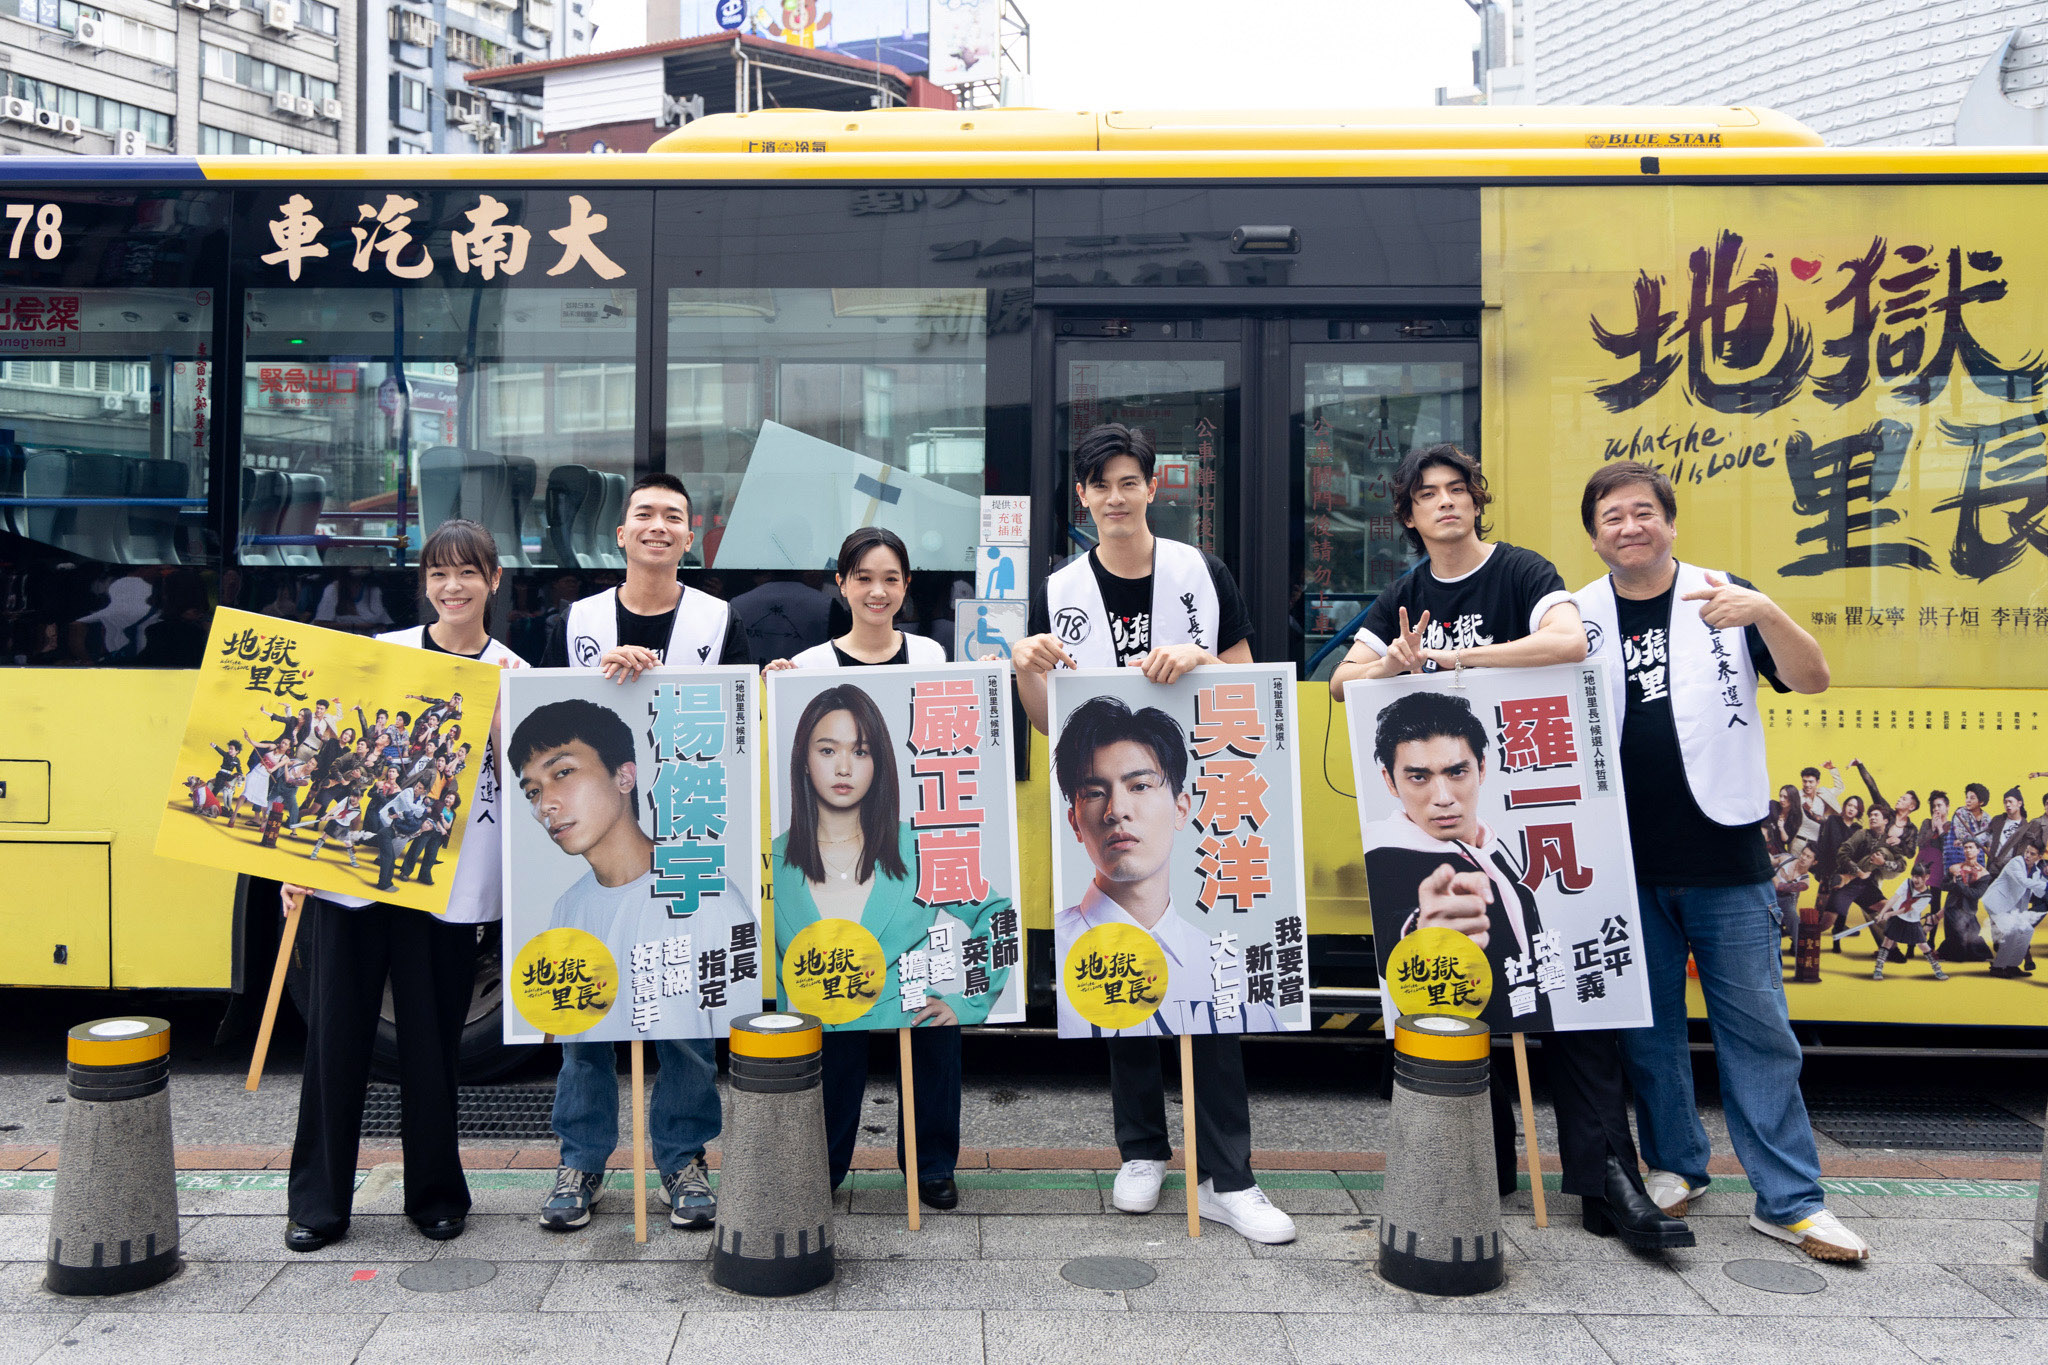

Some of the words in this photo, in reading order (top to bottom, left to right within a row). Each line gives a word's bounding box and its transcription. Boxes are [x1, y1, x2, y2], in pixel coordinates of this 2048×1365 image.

[1608, 133, 1660, 144] BLUE
[1669, 133, 1721, 144] STAR
[5, 203, 62, 260] 78
[1587, 228, 2048, 418] 地獄
[259, 368, 357, 393] 緊急出口
[268, 396, 324, 406] Emergency
[328, 396, 347, 406] Exit
[998, 513, 1023, 525] 充電
[1311, 416, 1334, 636] 公車關門後請勿上車
[1777, 408, 2048, 585] 里長
[998, 525, 1023, 537] 插座
[1055, 611, 1088, 642] 78
[1811, 611, 1837, 626] 導演
[1844, 605, 1906, 627] 瞿友寧
[1990, 605, 2048, 627] 李青蓉
[221, 628, 301, 668] 地獄
[245, 665, 309, 701] 里長
[647, 682, 729, 917] 楊傑宇
[906, 678, 990, 907] 嚴正嵐
[1189, 682, 1273, 914] 吳承洋
[1495, 695, 1594, 895] 羅一凡
[662, 934, 693, 998] 超級
[729, 921, 758, 984] 里長
[794, 947, 862, 977] 地獄
[927, 921, 957, 985] 可愛
[961, 936, 991, 999] 菜鳥
[989, 908, 1019, 971] 律師
[1074, 951, 1144, 980] 地獄
[1274, 915, 1304, 1008] 我要當
[1397, 954, 1467, 983] 地獄
[1600, 914, 1633, 978] 公平
[522, 956, 593, 987] 地獄
[551, 982, 608, 1012] 里長
[630, 940, 661, 1033] 好幫手
[698, 948, 728, 1011] 指定
[822, 971, 877, 1000] 里長
[898, 950, 928, 1012] 擔當
[1103, 976, 1159, 1006] 里長
[1210, 929, 1241, 1021] 大仁哥
[1245, 942, 1275, 1005] 新版
[1427, 978, 1484, 1008] 里長
[1503, 953, 1538, 1018] 社會
[1571, 938, 1607, 1004] 正義
[1818, 1180, 1893, 1194] LIN
[1902, 1182, 2032, 1198] GREEN
